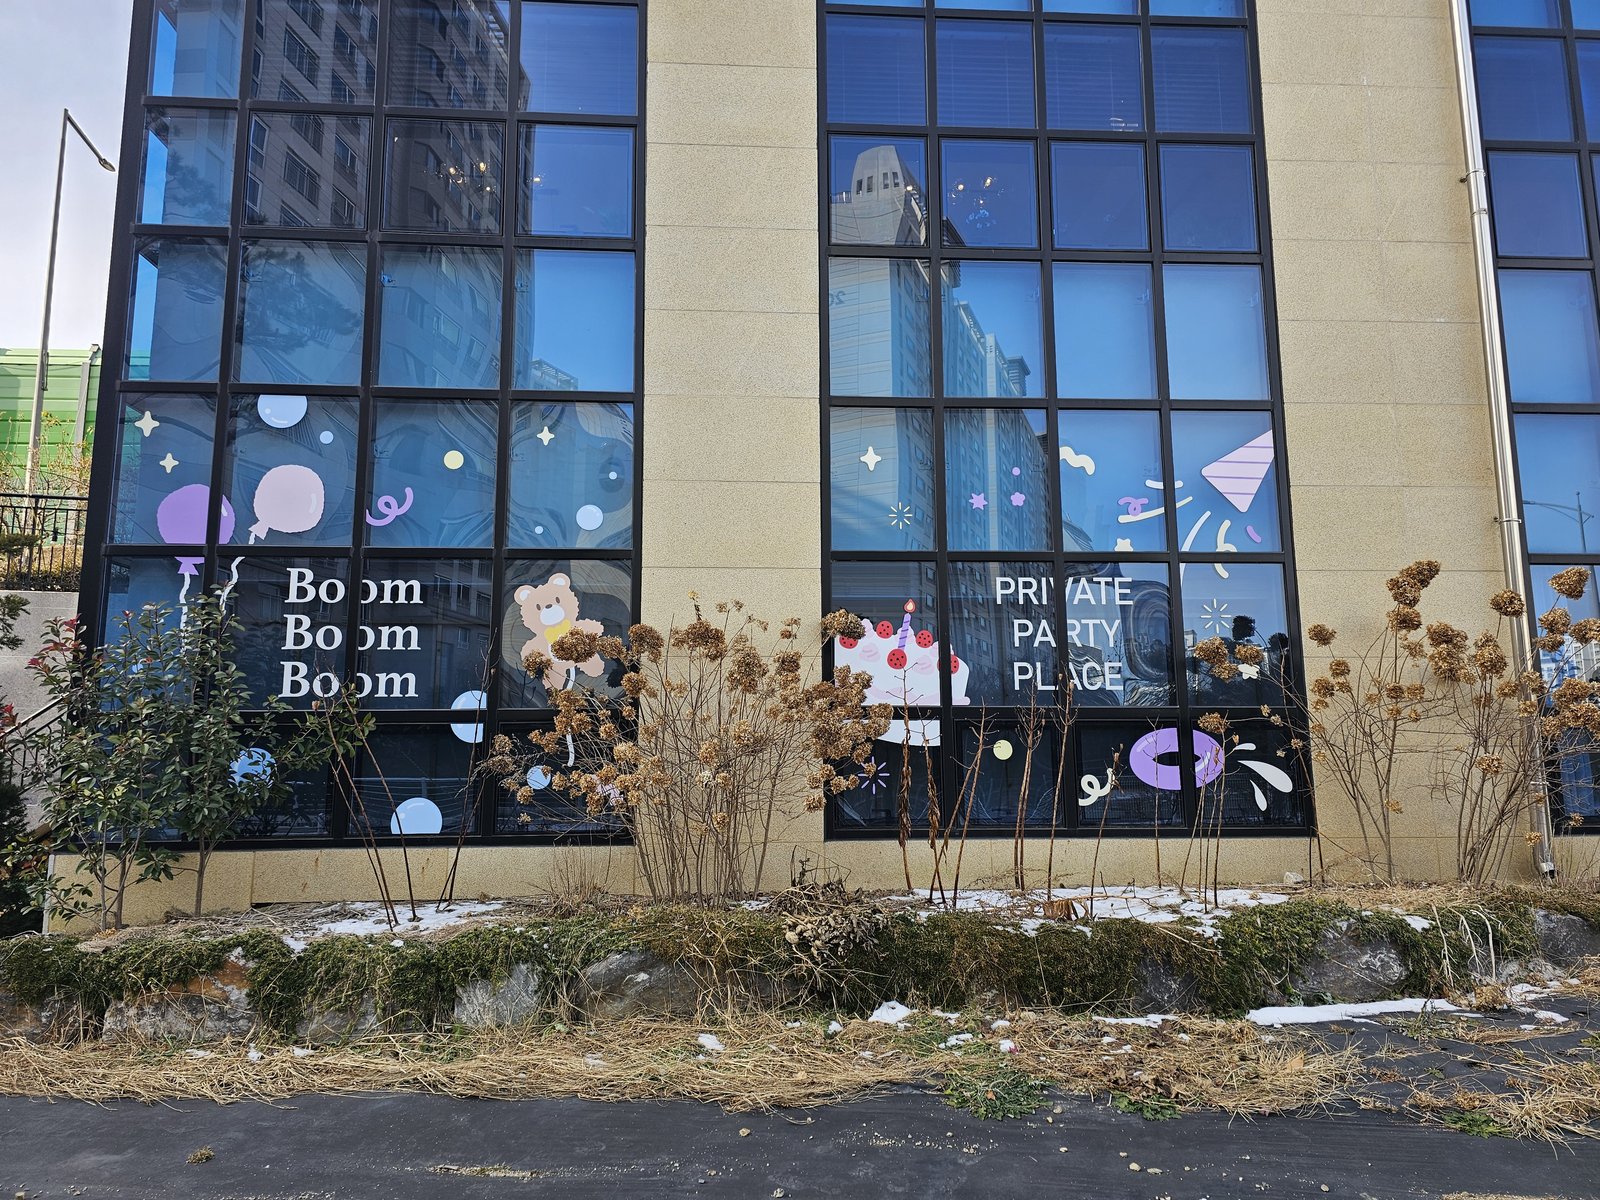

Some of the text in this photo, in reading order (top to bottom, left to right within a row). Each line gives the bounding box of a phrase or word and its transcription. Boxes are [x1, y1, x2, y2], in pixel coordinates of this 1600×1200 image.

[284, 567, 424, 604] Boom
[281, 613, 421, 651] Boom
[1013, 619, 1121, 648] PARTY
[278, 661, 419, 698] Boom
